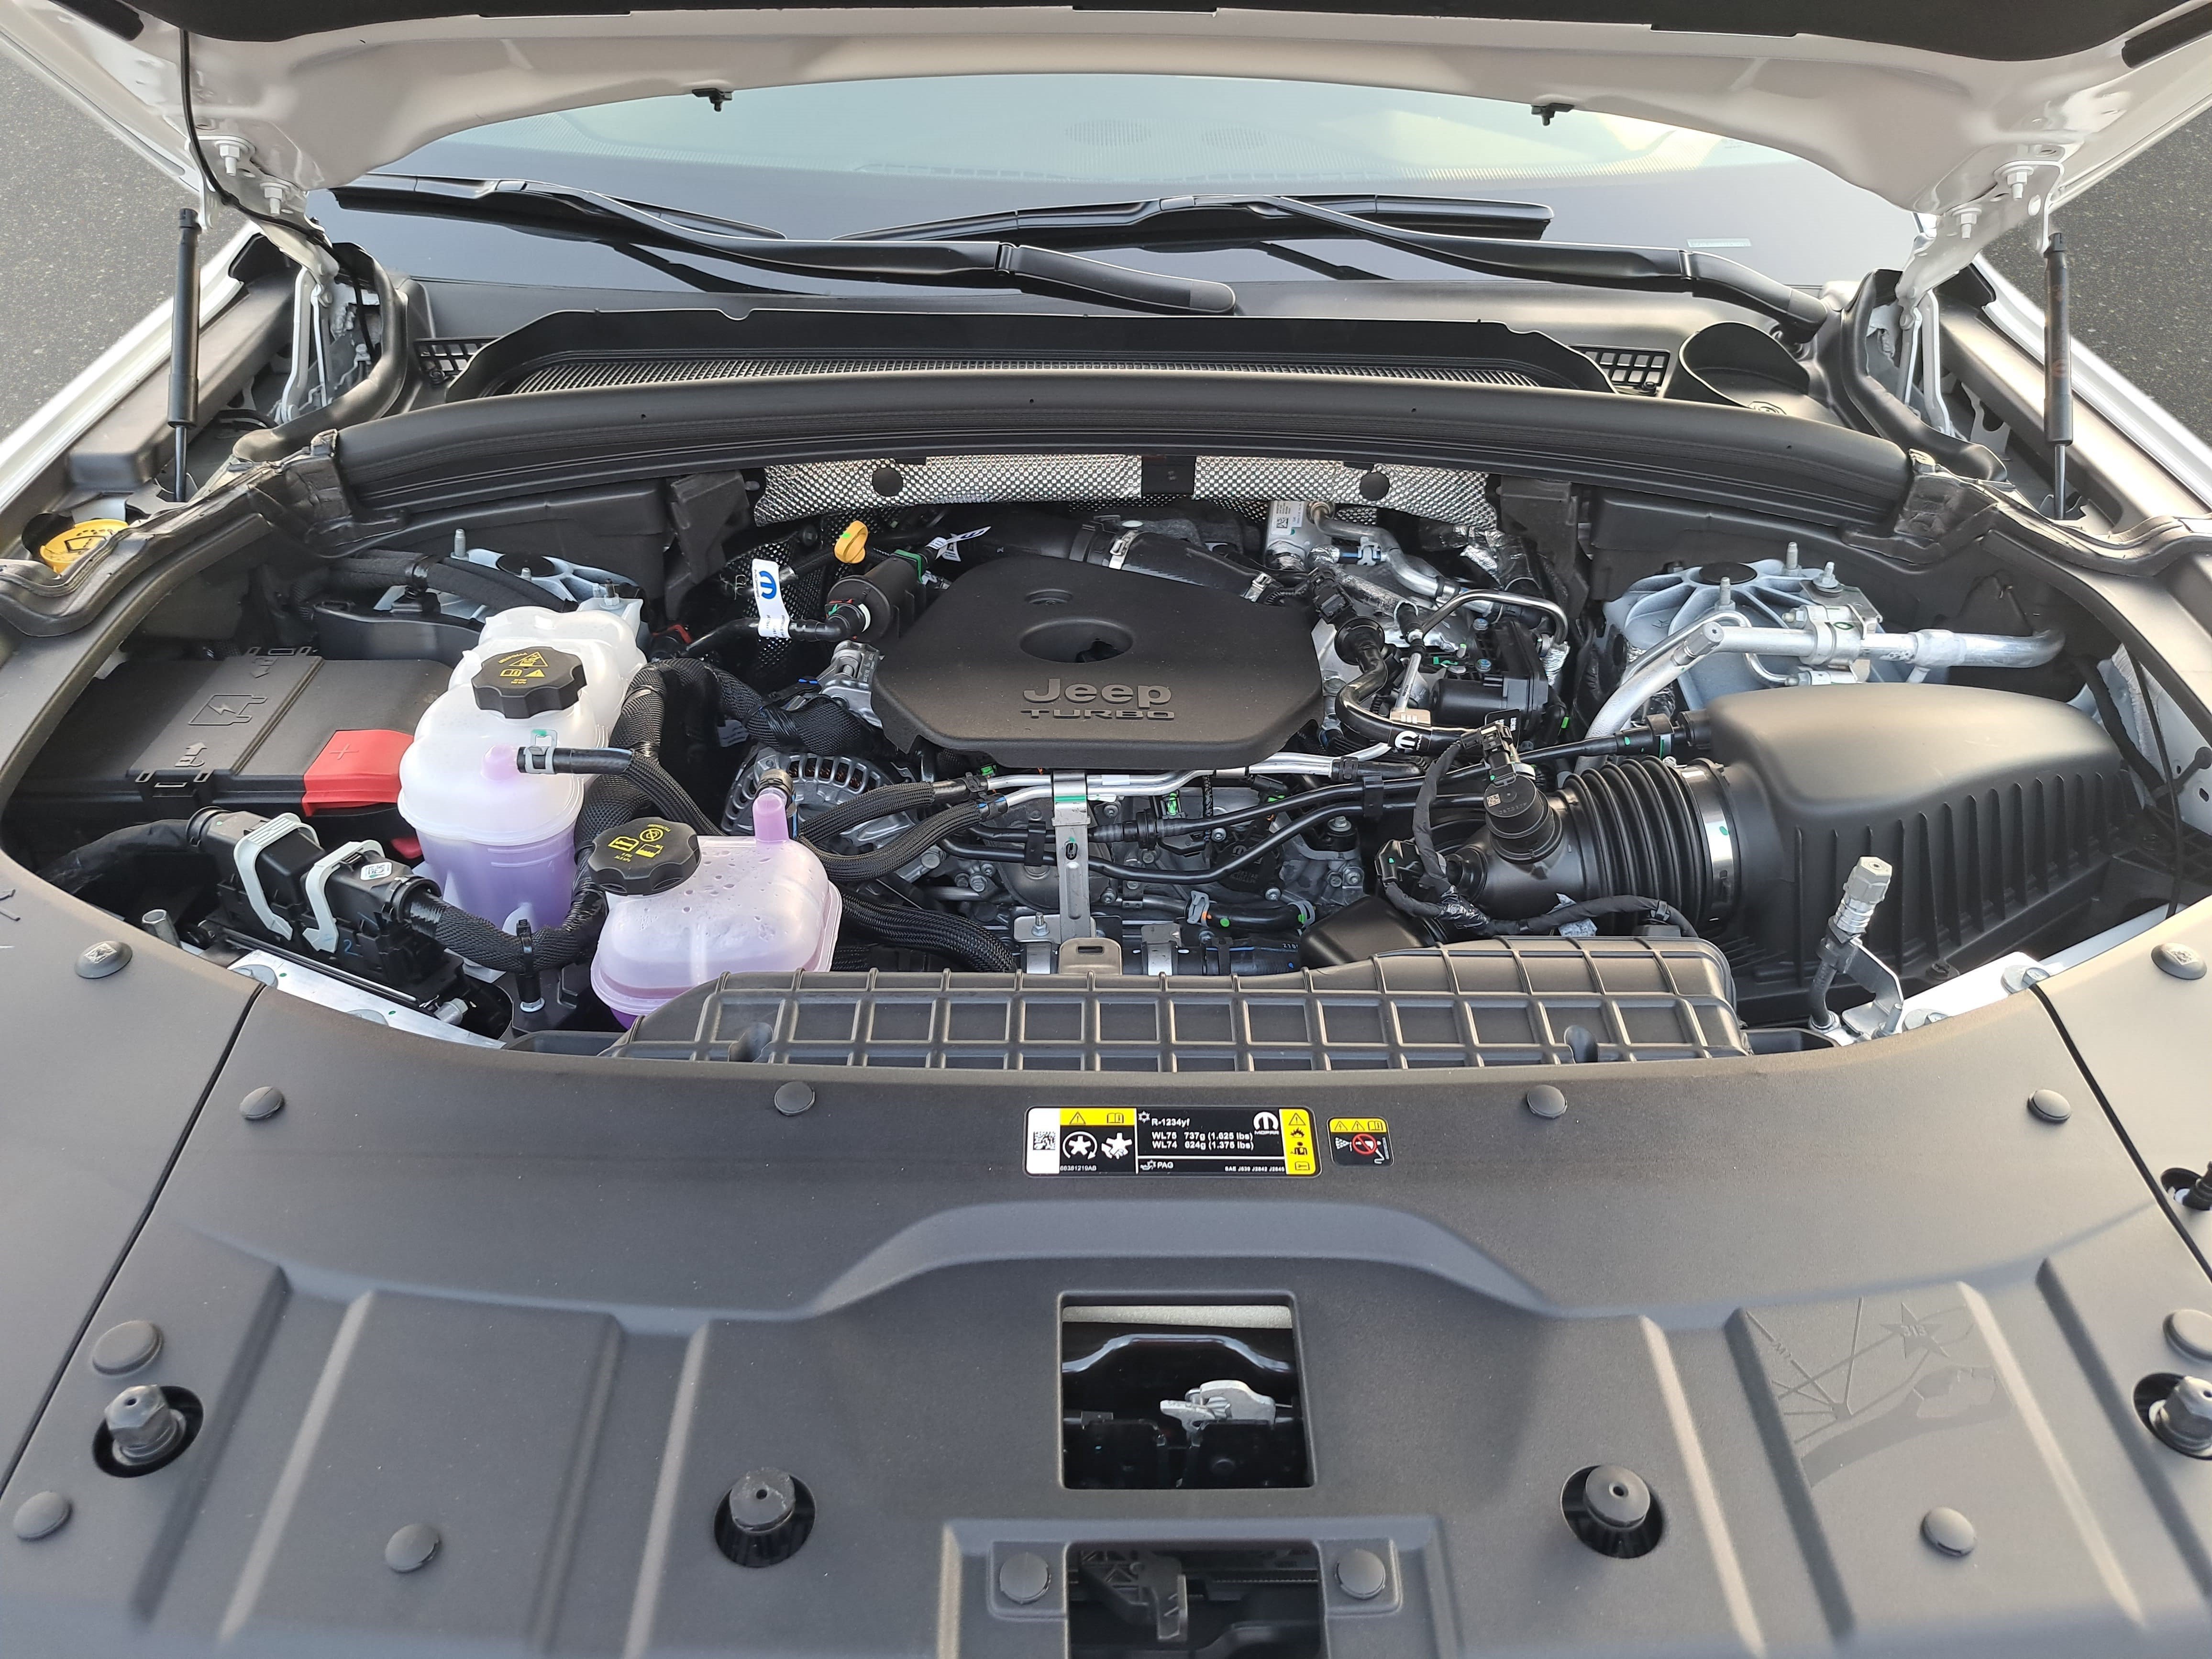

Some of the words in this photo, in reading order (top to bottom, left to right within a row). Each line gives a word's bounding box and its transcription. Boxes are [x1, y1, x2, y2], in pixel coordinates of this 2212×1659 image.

[1024, 678, 1171, 709] Jeep
[1020, 709, 1174, 720] TURBO
[1151, 1118, 1190, 1128] R-1234yf
[1184, 1132, 1206, 1141] 737g
[1236, 1131, 1253, 1141] lbs)
[1152, 1140, 1177, 1149] WL74
[1184, 1141, 1206, 1150] 624g
[1237, 1141, 1254, 1150] lbs)
